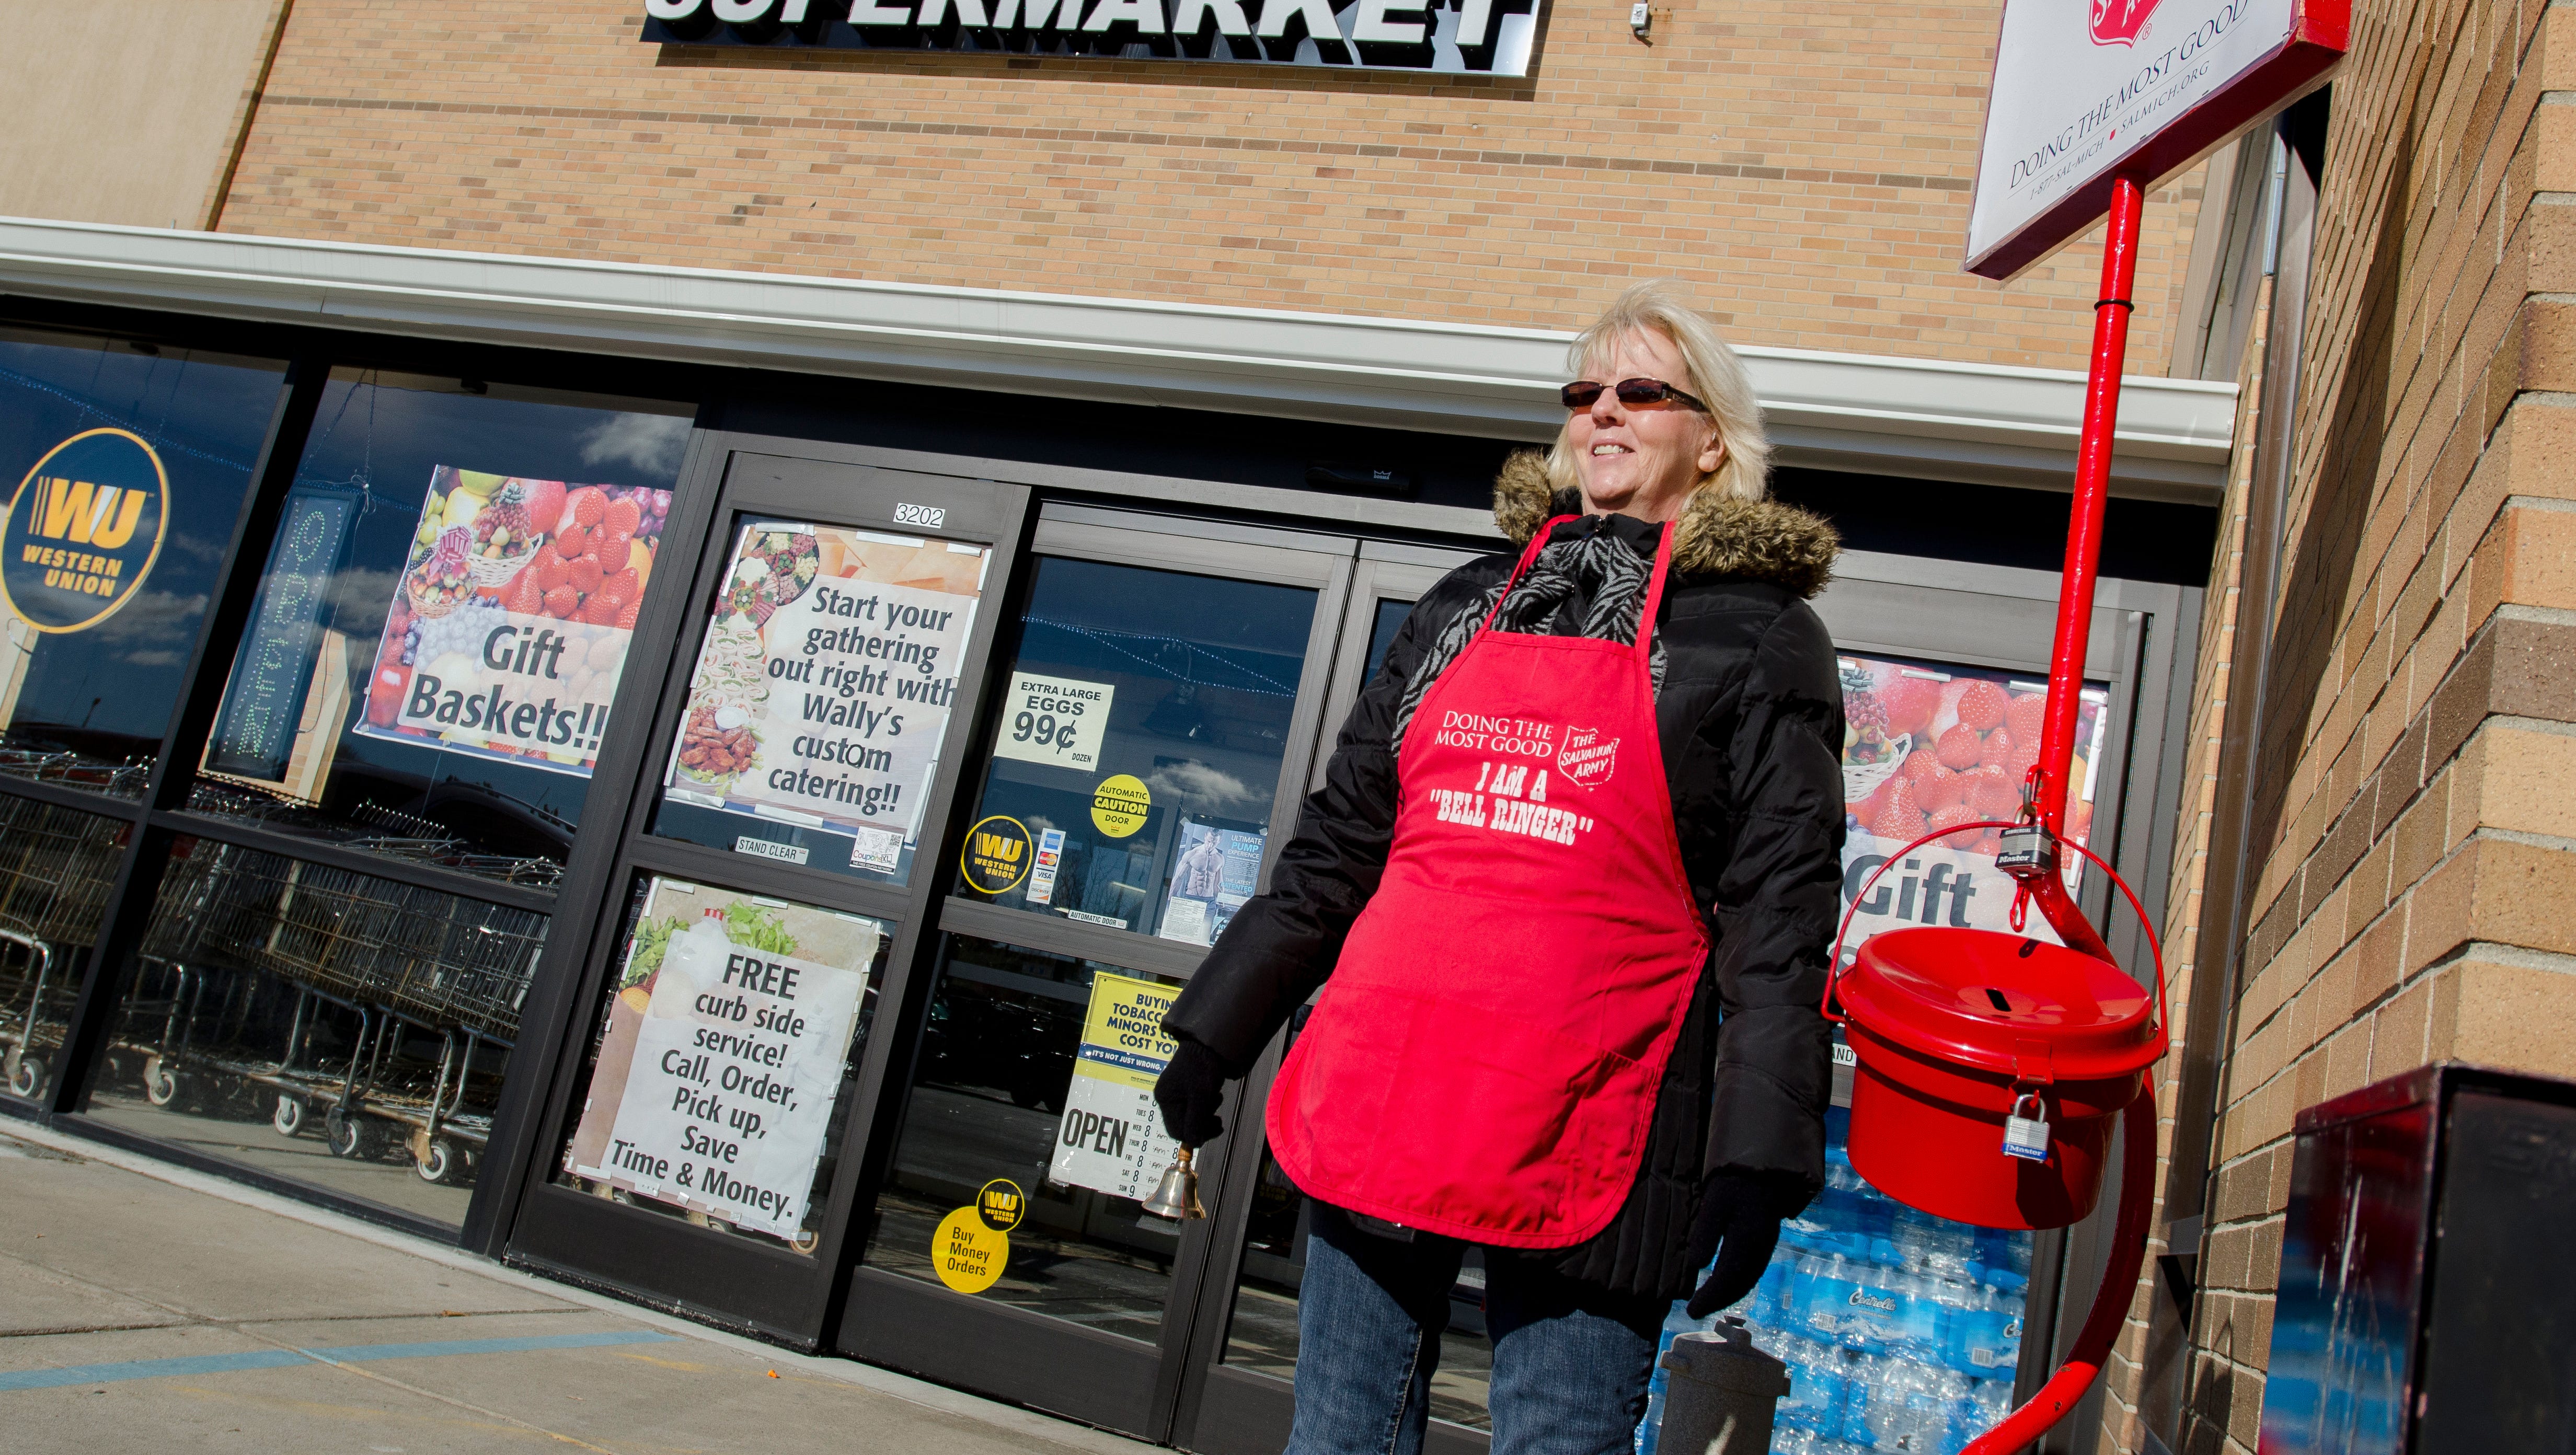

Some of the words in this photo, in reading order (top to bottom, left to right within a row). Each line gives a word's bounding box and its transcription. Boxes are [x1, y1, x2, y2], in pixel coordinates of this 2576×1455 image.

[2010, 125, 2074, 190] DOING
[2078, 94, 2113, 140] THE
[2115, 47, 2177, 111] MOST
[2180, 0, 2248, 61] GOOD
[2030, 137, 2104, 201] 1-877-SAL-MICH
[2121, 60, 2210, 133] SALMICH.ORG
[896, 504, 943, 526] 3202
[22, 544, 123, 578] WESTERN
[44, 569, 116, 597] UNION
[811, 586, 879, 621] Start
[884, 603, 953, 631] your
[483, 625, 565, 680] Gift
[802, 626, 940, 674] gathering
[768, 657, 814, 684] out
[819, 661, 889, 698] right
[897, 675, 956, 707] with
[1021, 682, 1059, 695] EXTRA
[1062, 687, 1101, 701] LARGE
[406, 674, 608, 750] Baskets!!
[803, 693, 903, 739] Wally's
[1026, 695, 1085, 716] EGGS
[1013, 711, 1077, 755] 99¢
[1443, 710, 1510, 734] DOING
[1515, 720, 1554, 740] THE
[1434, 730, 1489, 749] MOST
[1491, 736, 1552, 757] GOOD
[1573, 733, 1596, 748] THE
[792, 735, 892, 772] custom
[1072, 753, 1092, 763] DOZEN
[1573, 758, 1609, 778] ARMY
[768, 768, 901, 816] catering!!
[1475, 761, 1491, 791] I
[1489, 764, 1528, 798] AM
[1530, 769, 1548, 802] A
[1100, 786, 1147, 800] AUTOMATIC
[1095, 797, 1148, 815] CAUTION
[1105, 815, 1129, 825] DOOR
[739, 839, 766, 853] STAND
[769, 845, 797, 860] CLEAR
[1231, 835, 1262, 845] ULTIMATE
[1232, 841, 1259, 852] PUMP
[1228, 849, 1260, 859] EXPERIENCE
[1998, 855, 2030, 863] Master
[974, 857, 1017, 873] WESTERN
[985, 868, 1015, 880] UNION
[1037, 871, 1052, 880] VISA
[1221, 882, 1253, 892] PATENTED
[1844, 854, 1977, 928] Gift
[1071, 911, 1101, 922] AUTOMATIC
[1102, 917, 1117, 926] DOOR
[722, 953, 800, 1000] FREE
[1113, 1002, 1162, 1023] TOBACC
[1136, 994, 1174, 1011] BUYIN
[695, 994, 748, 1022] curb
[753, 1004, 804, 1037] side
[1107, 1016, 1157, 1037] MINORS
[693, 1028, 788, 1068] service!
[1120, 1034, 1152, 1050] COST
[1092, 1049, 1104, 1058] IT'S
[1105, 1053, 1119, 1061] NOT
[1119, 1056, 1135, 1065] JUST
[1136, 1059, 1162, 1071] WRONG.
[661, 1049, 710, 1088] Call,
[721, 1065, 798, 1112] Order,
[671, 1086, 723, 1123] Pick
[729, 1108, 767, 1139] up,
[1136, 1108, 1146, 1117] TUES
[1148, 1110, 1155, 1122] 8
[1062, 1107, 1129, 1158] OPEN
[1132, 1124, 1142, 1132] WED
[1144, 1125, 1151, 1137] 8
[681, 1125, 739, 1164] Save
[1129, 1138, 1140, 1147] THUR
[1141, 1140, 1148, 1152] 8
[1172, 1147, 1179, 1160] 8
[2009, 1145, 2043, 1157] Master
[1137, 1155, 1144, 1168] 8
[611, 1139, 669, 1180] Time
[675, 1162, 694, 1187] &
[700, 1167, 792, 1222] Money.
[1133, 1170, 1140, 1182] 8
[1118, 1184, 1128, 1193] SUN
[1129, 1185, 1135, 1197] 9
[985, 1208, 1015, 1218] WESTERN
[993, 1215, 1014, 1223] UNION
[952, 1226, 974, 1245] Buy
[949, 1242, 991, 1264] Money
[947, 1258, 987, 1277] Orders
[1849, 1290, 1896, 1311] Centrella
